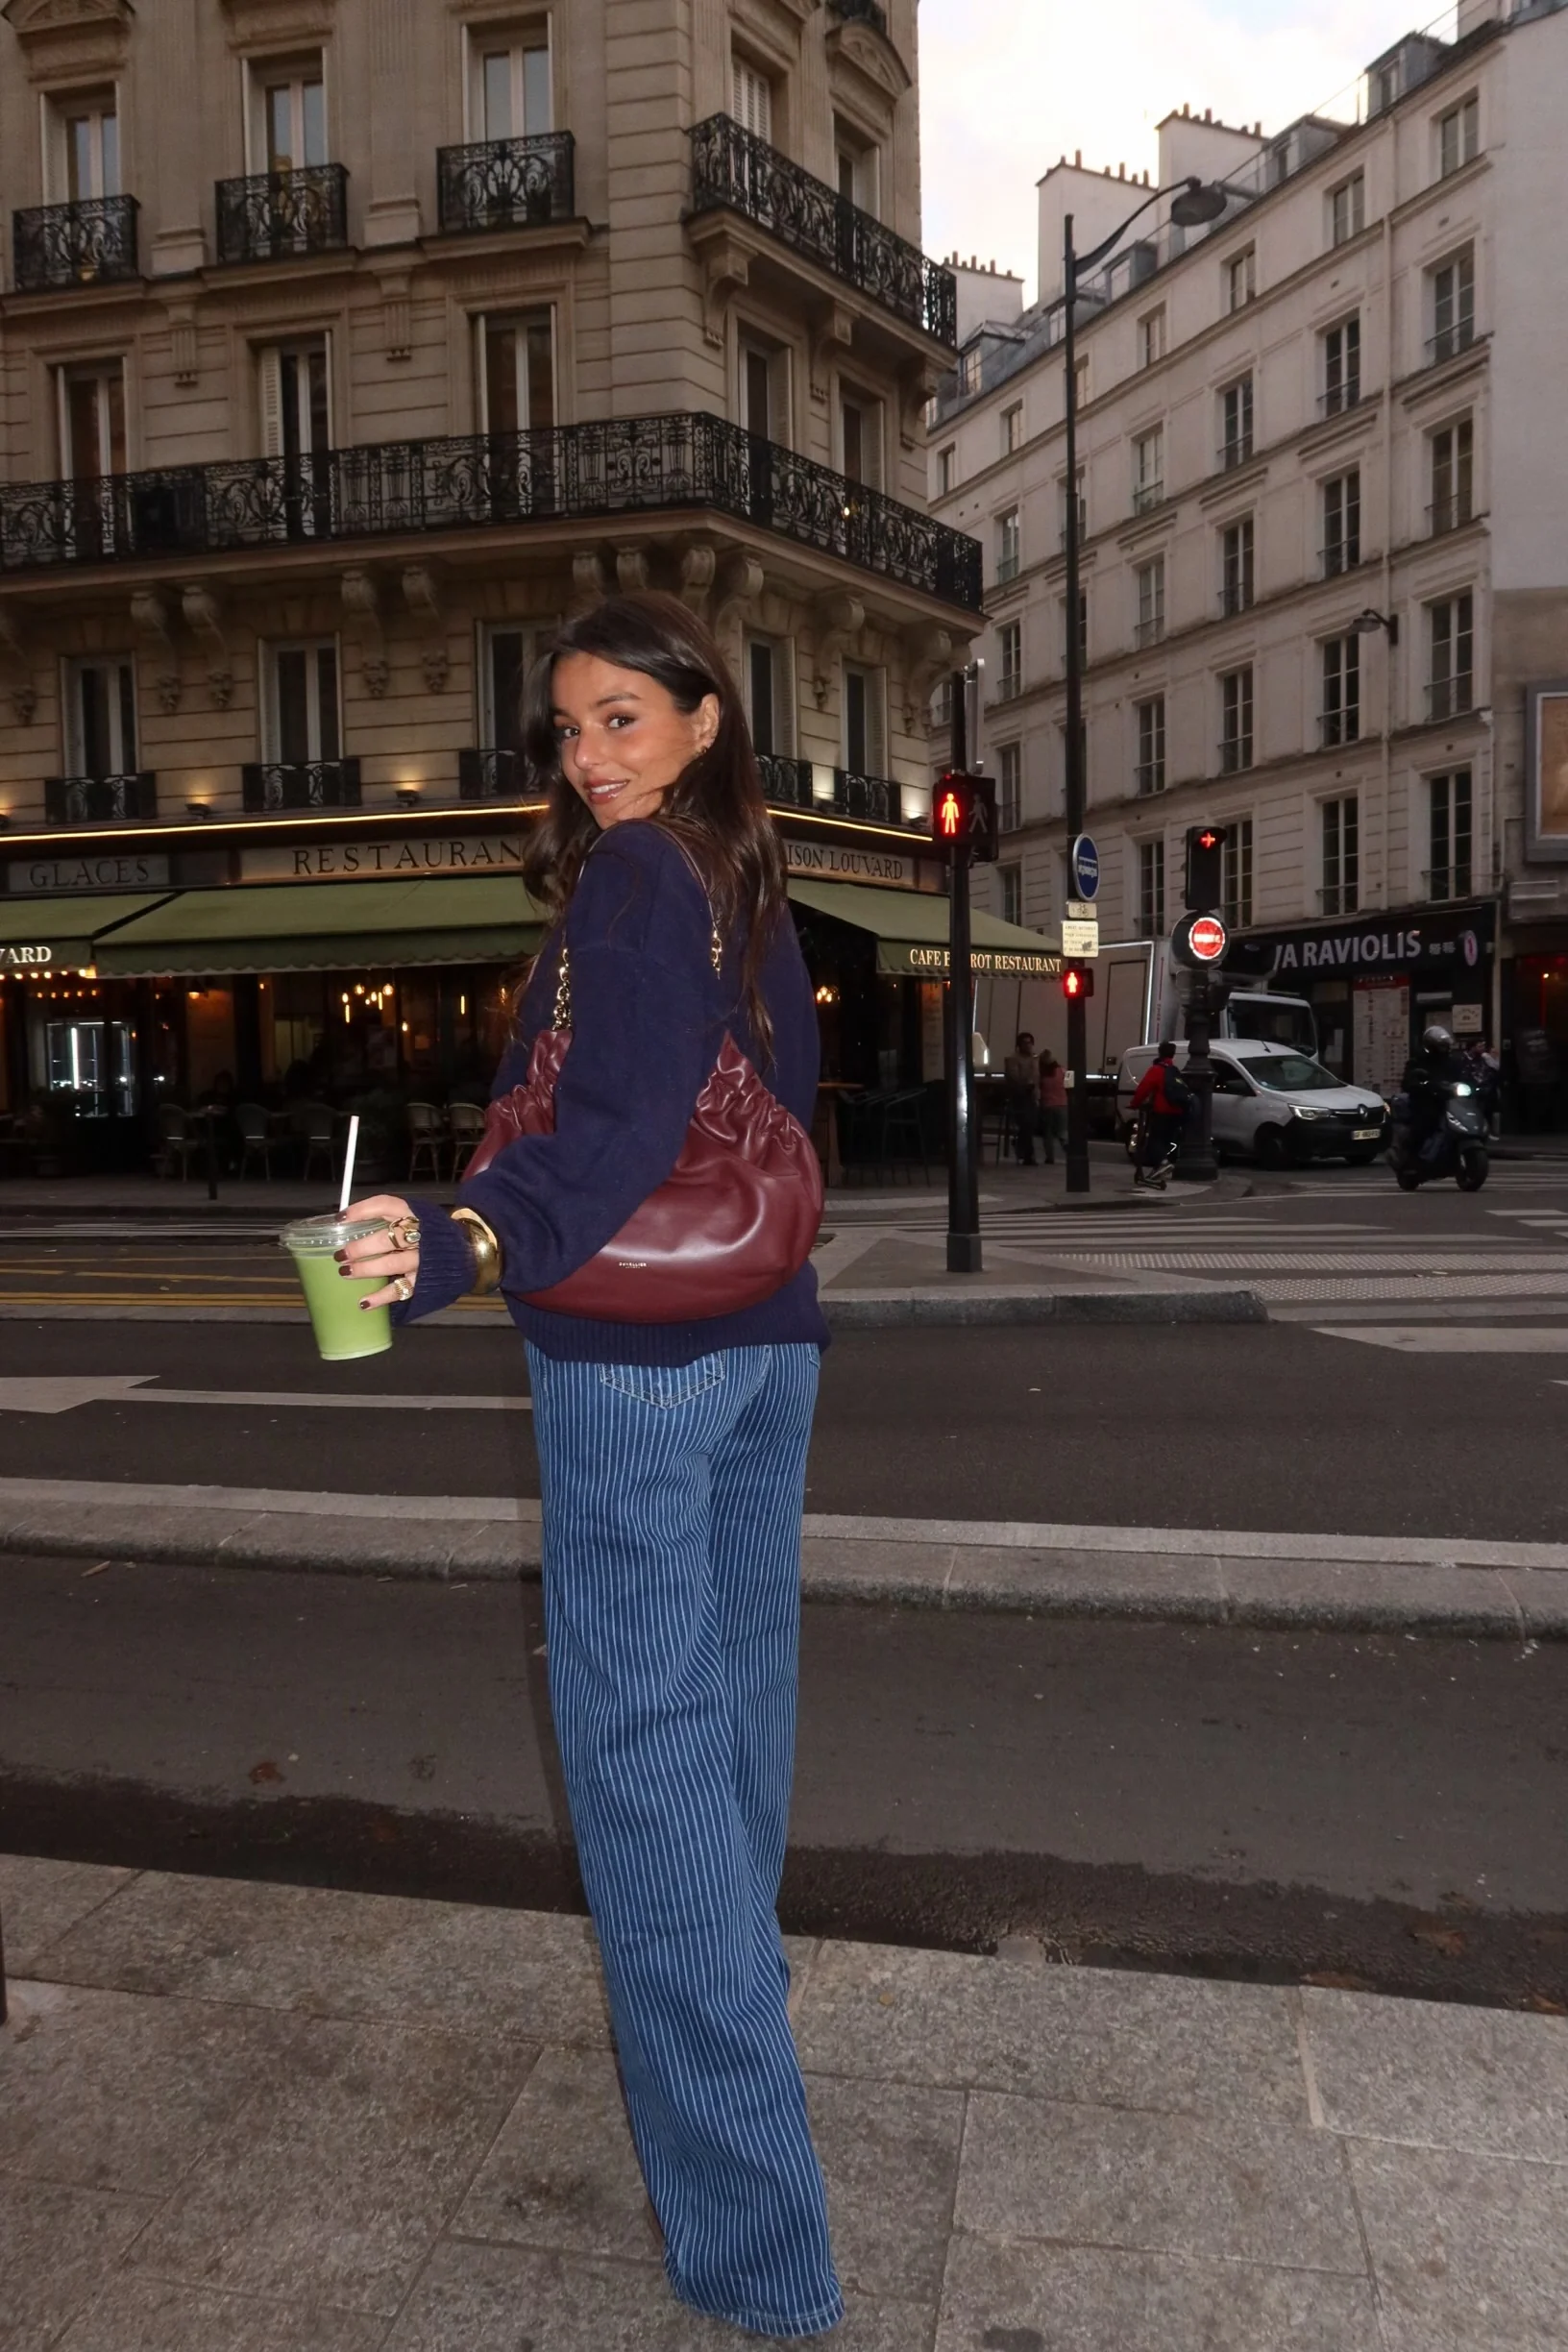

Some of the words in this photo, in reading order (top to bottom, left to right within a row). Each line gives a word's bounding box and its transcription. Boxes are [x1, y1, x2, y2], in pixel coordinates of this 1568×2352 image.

[29, 858, 150, 888] GLACES
[292, 838, 523, 875] RESTAURAN
[788, 845, 824, 870] ISON
[829, 850, 903, 879] LOUVARD
[910, 948, 942, 967] CAFE
[994, 955, 1062, 972] RESTAURANT
[1302, 929, 1422, 967] RAVIOLIS
